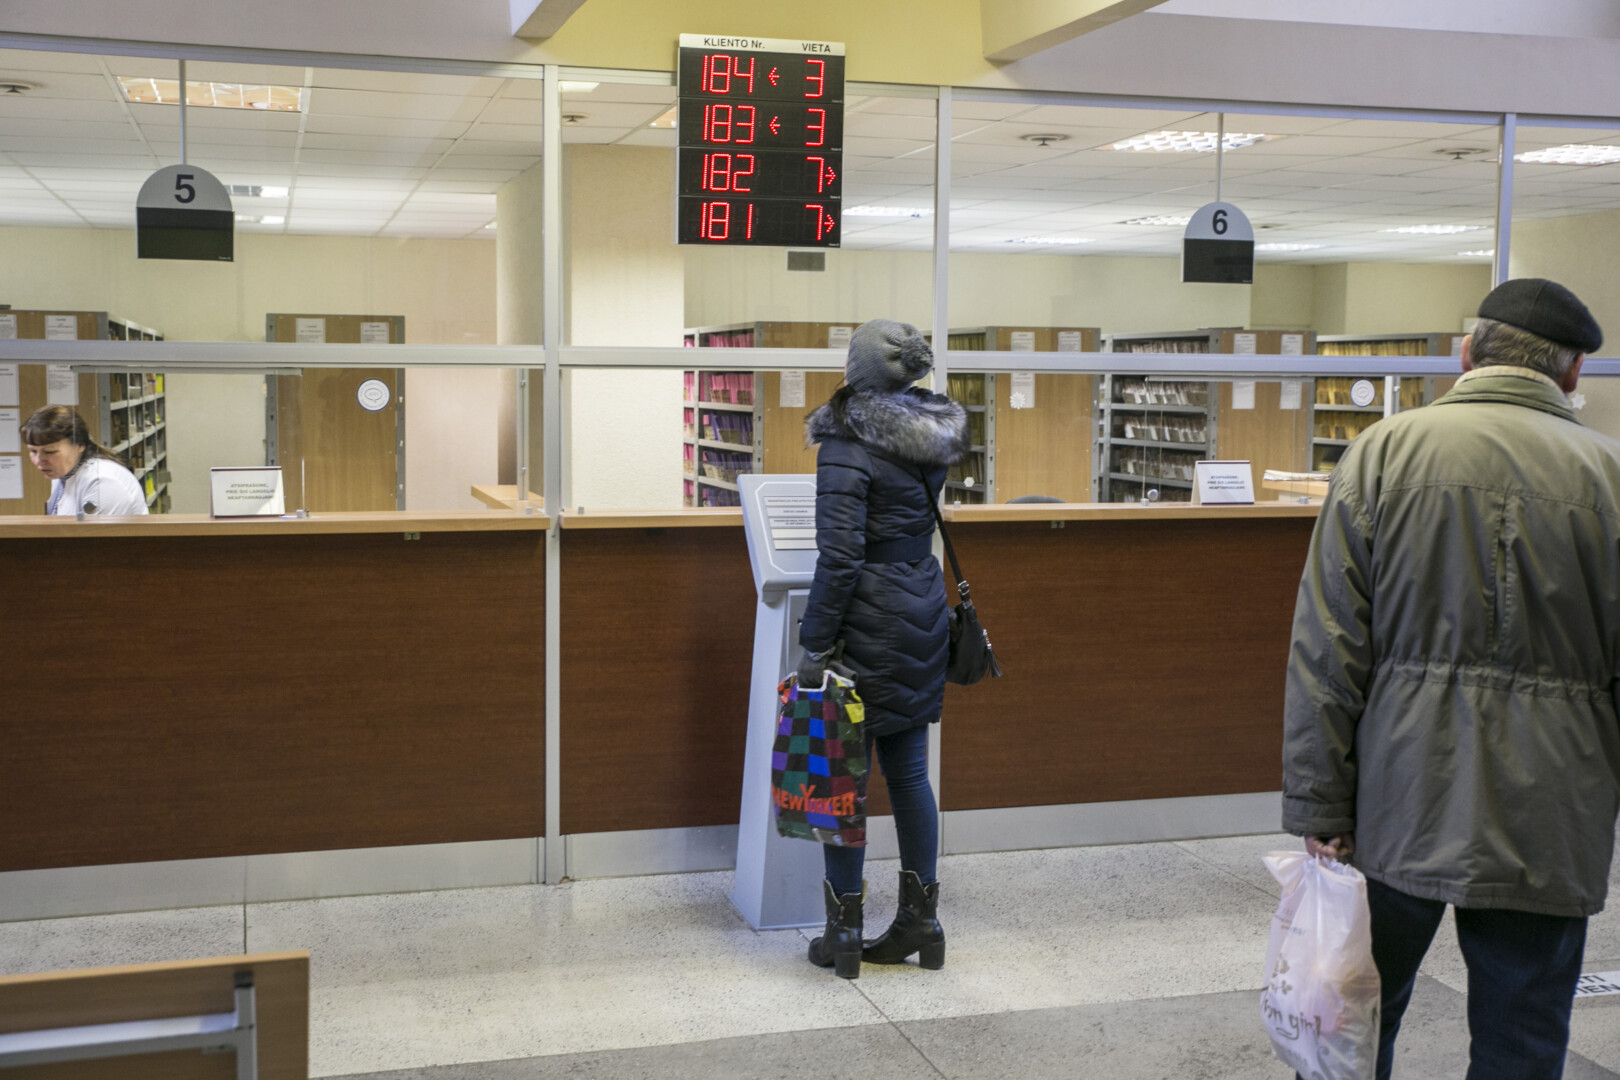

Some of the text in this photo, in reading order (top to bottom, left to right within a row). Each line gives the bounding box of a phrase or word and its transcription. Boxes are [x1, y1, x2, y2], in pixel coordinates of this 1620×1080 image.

[703, 37, 831, 53] KLIENTO Nr. VIETA
[702, 54, 825, 98] 184 3
[702, 104, 826, 147] 183 3
[174, 173, 196, 204] 5
[702, 153, 825, 194] 182 7
[700, 201, 824, 242] 181 7
[1212, 209, 1228, 236] 6
